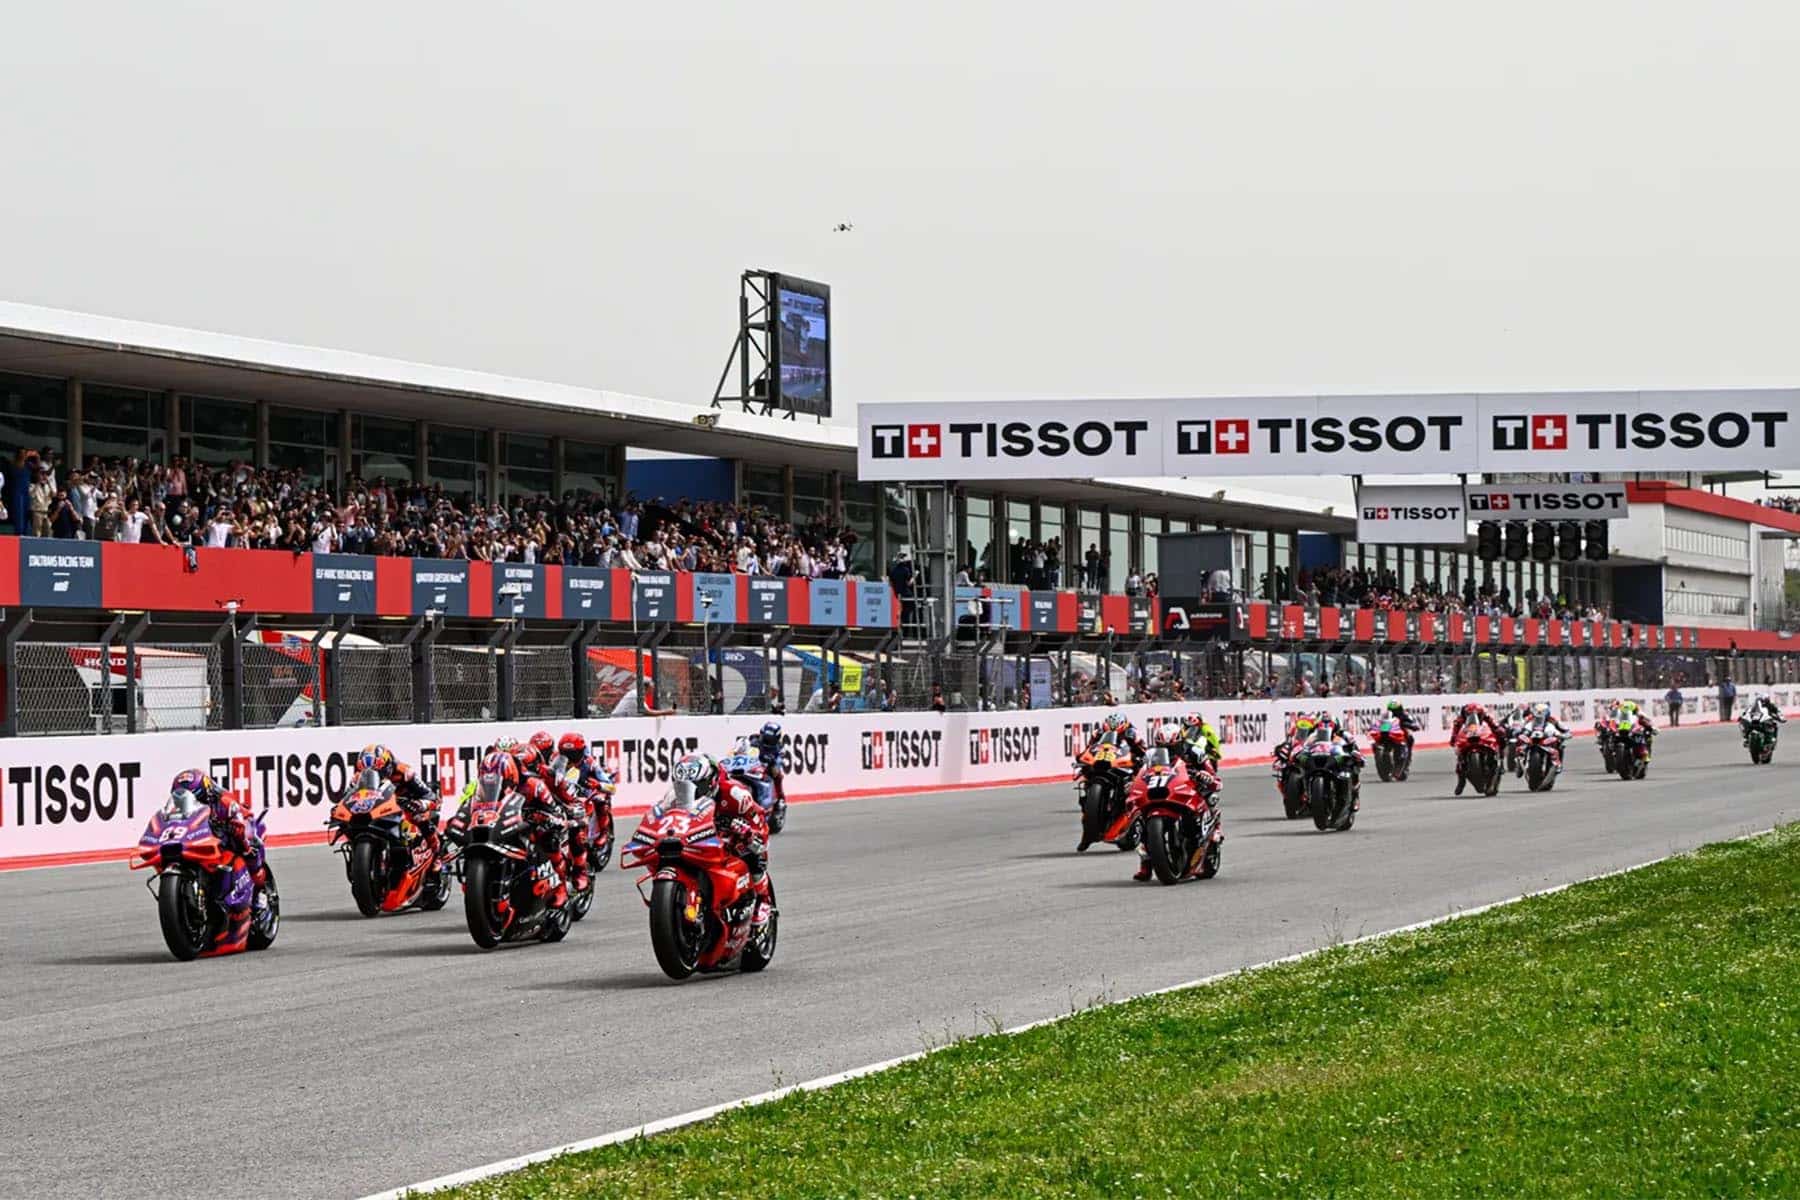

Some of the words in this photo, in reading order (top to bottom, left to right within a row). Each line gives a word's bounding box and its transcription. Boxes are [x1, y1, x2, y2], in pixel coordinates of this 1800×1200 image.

[949, 420, 1148, 458] TISSOT
[1258, 416, 1463, 454] TISSOT
[1576, 412, 1788, 449] TISSOT
[1391, 507, 1460, 520] TISSOT
[1513, 492, 1624, 510] TISSOT
[991, 726, 1040, 763] TISSOT
[1233, 713, 1268, 744] TISSOT
[886, 730, 942, 768] TISSOT
[9, 762, 141, 826] TISSOT
[657, 815, 691, 835] 23
